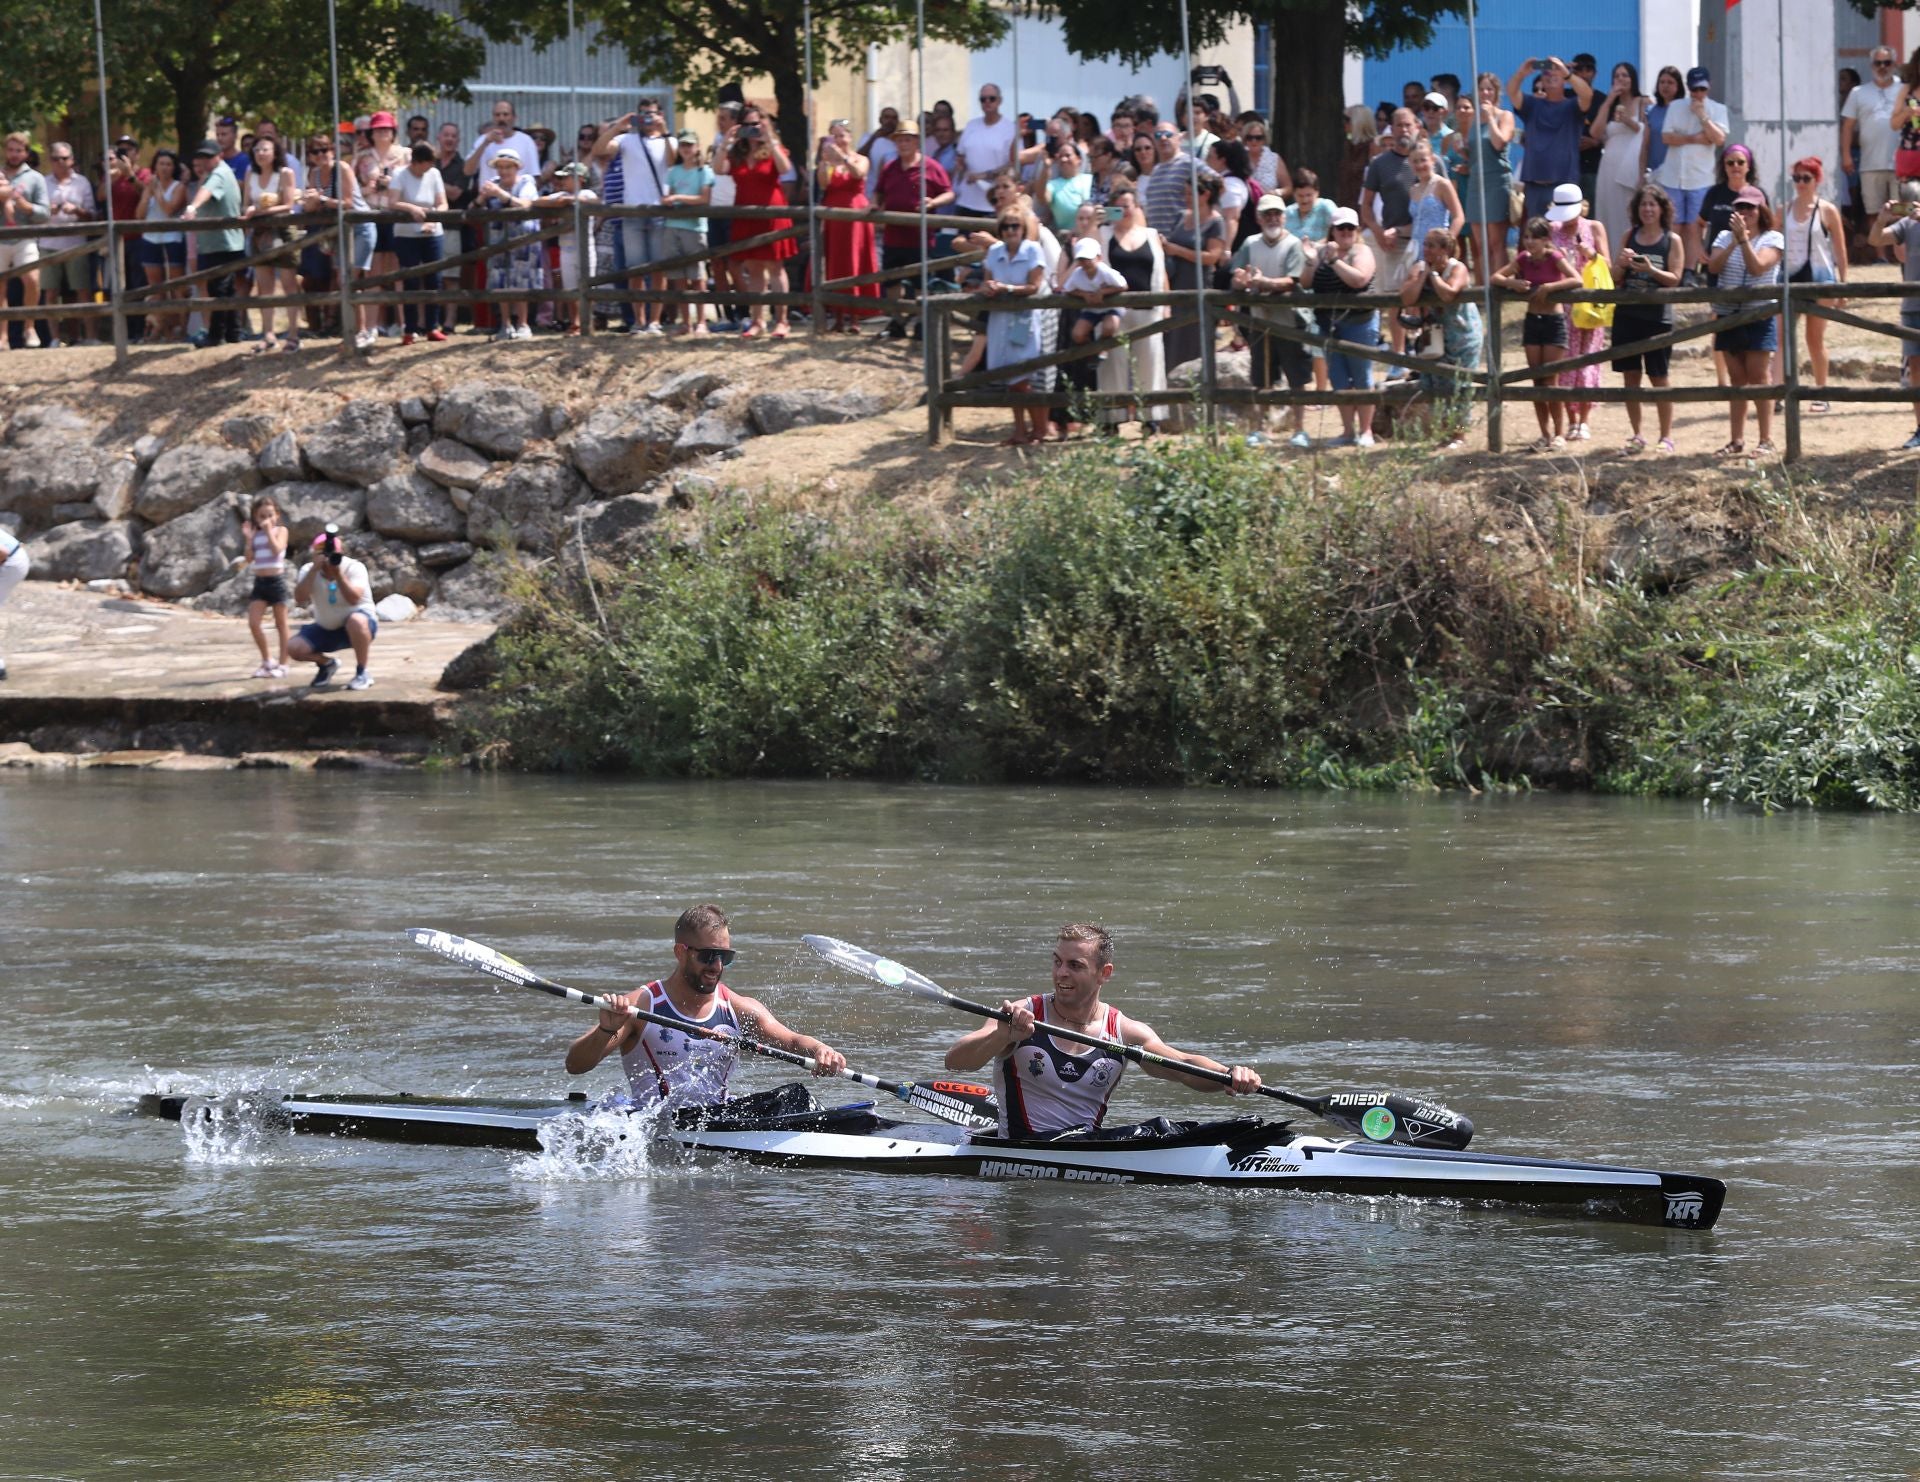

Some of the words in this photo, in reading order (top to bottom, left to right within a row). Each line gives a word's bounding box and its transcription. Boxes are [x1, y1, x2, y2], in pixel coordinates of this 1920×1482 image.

[492, 968, 525, 986] ASTURIAS
[936, 1082, 987, 1095] NELO
[913, 1084, 965, 1111] AYUNTAMIENTO
[963, 1103, 975, 1115] DE
[908, 1094, 971, 1127] RIBADESELLA
[1413, 1107, 1463, 1130] JANTEX
[1260, 1164, 1302, 1172] RACING
[1665, 1201, 1704, 1220] KR
